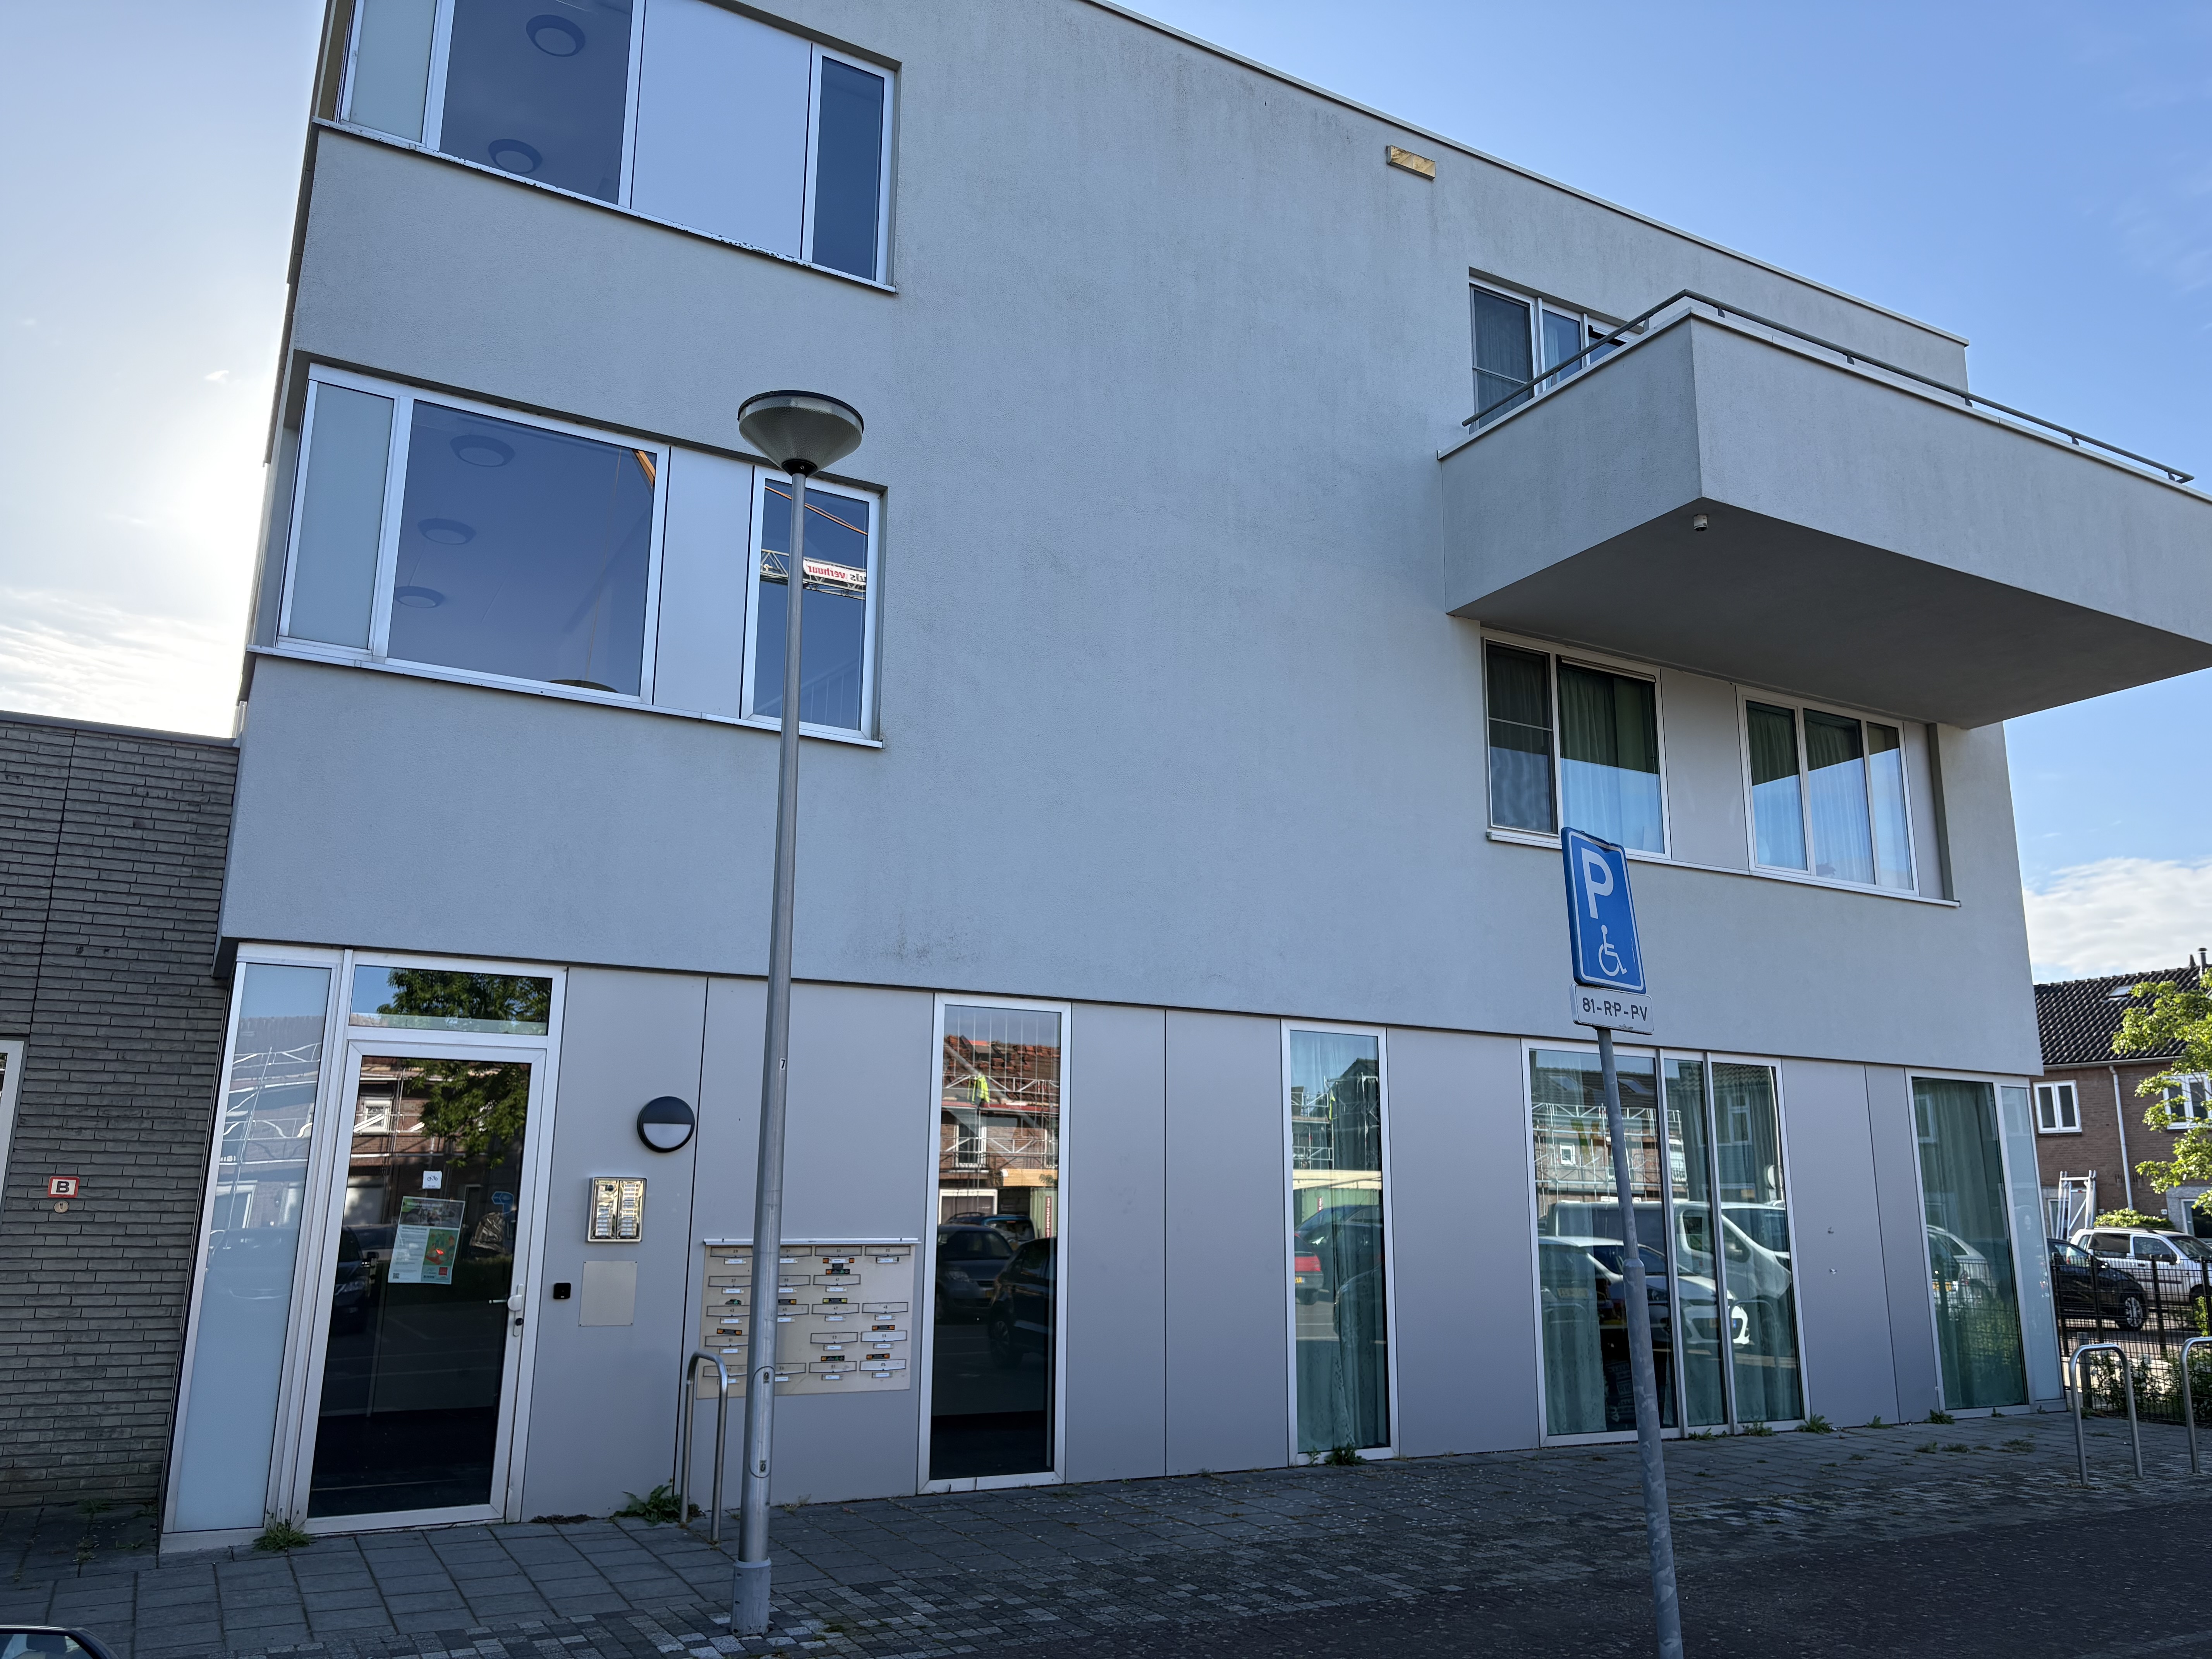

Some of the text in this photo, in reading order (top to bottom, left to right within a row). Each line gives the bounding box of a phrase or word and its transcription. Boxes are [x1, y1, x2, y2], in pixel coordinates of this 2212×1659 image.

[1581, 847, 1614, 920] P
[1582, 997, 1648, 1022] 81-RP-PV
[56, 1181, 70, 1193] B
